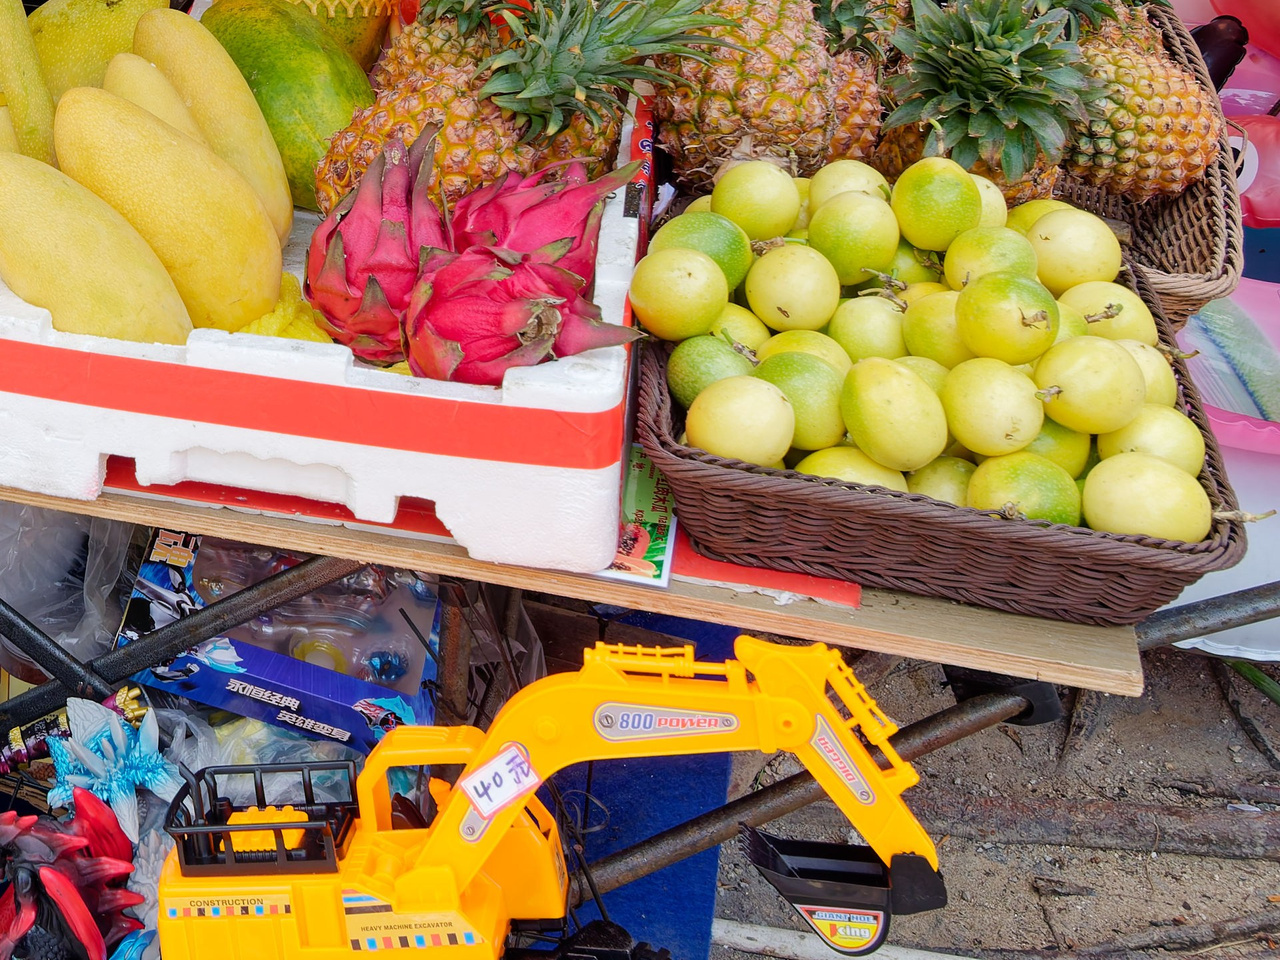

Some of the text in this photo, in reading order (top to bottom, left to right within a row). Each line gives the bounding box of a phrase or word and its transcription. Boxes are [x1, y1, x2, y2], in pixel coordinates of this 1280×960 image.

[225, 678, 301, 711] 永恒经典
[619, 712, 654, 730] 800
[472, 753, 531, 803] 40元
[189, 897, 264, 908] CONSTRUCTION
[815, 910, 874, 923] GIANT HOE
[360, 921, 454, 933] HEAVY MACHINE EXCAVATOR
